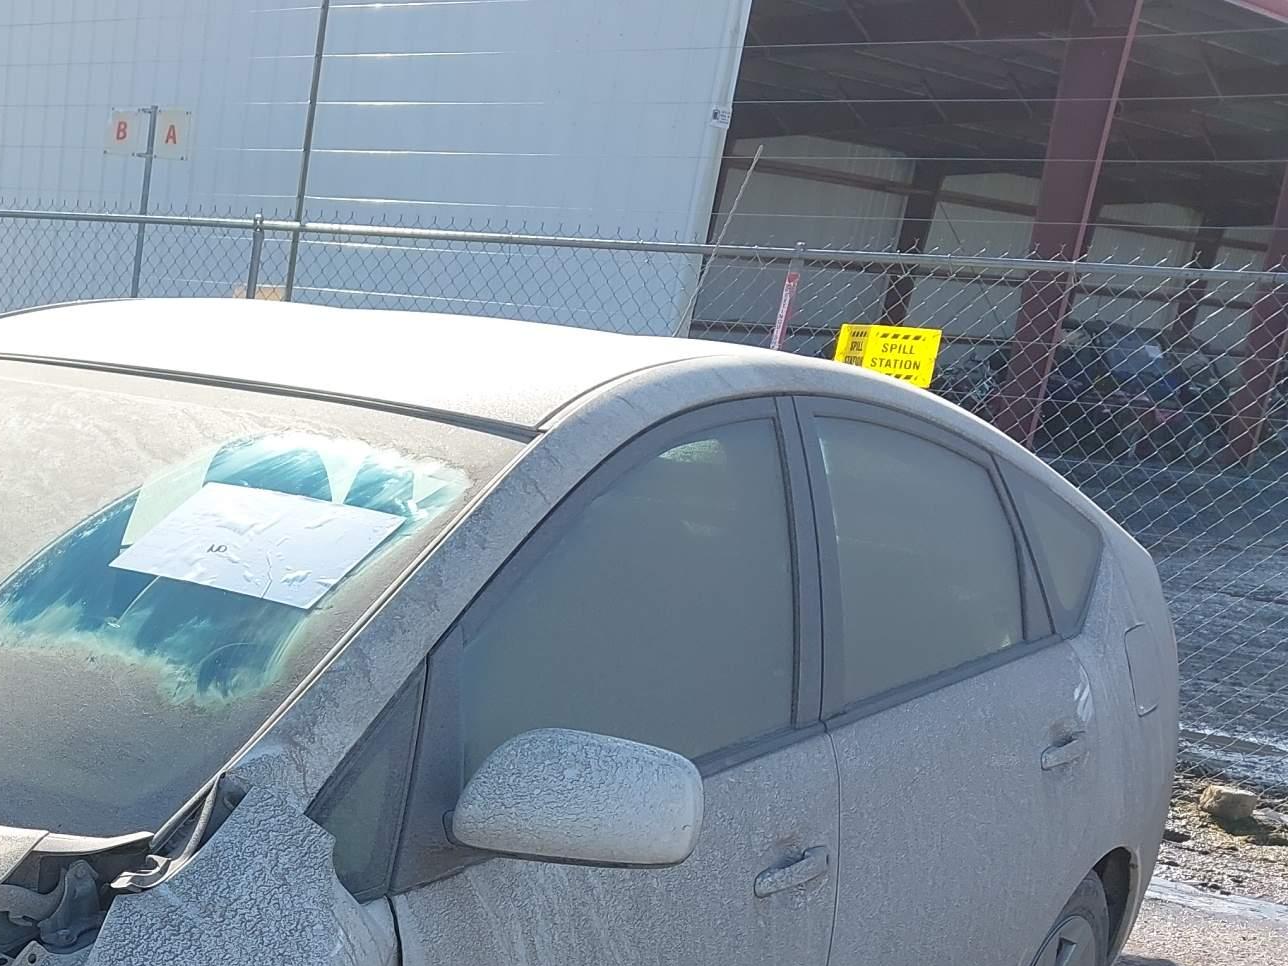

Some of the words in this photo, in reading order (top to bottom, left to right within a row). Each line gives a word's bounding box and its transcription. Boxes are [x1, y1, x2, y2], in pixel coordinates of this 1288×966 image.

[116, 121, 128, 140] B
[165, 124, 177, 145] A
[850, 341, 864, 352] SPILL
[881, 342, 916, 355] SPILL
[870, 357, 921, 371] STATION
